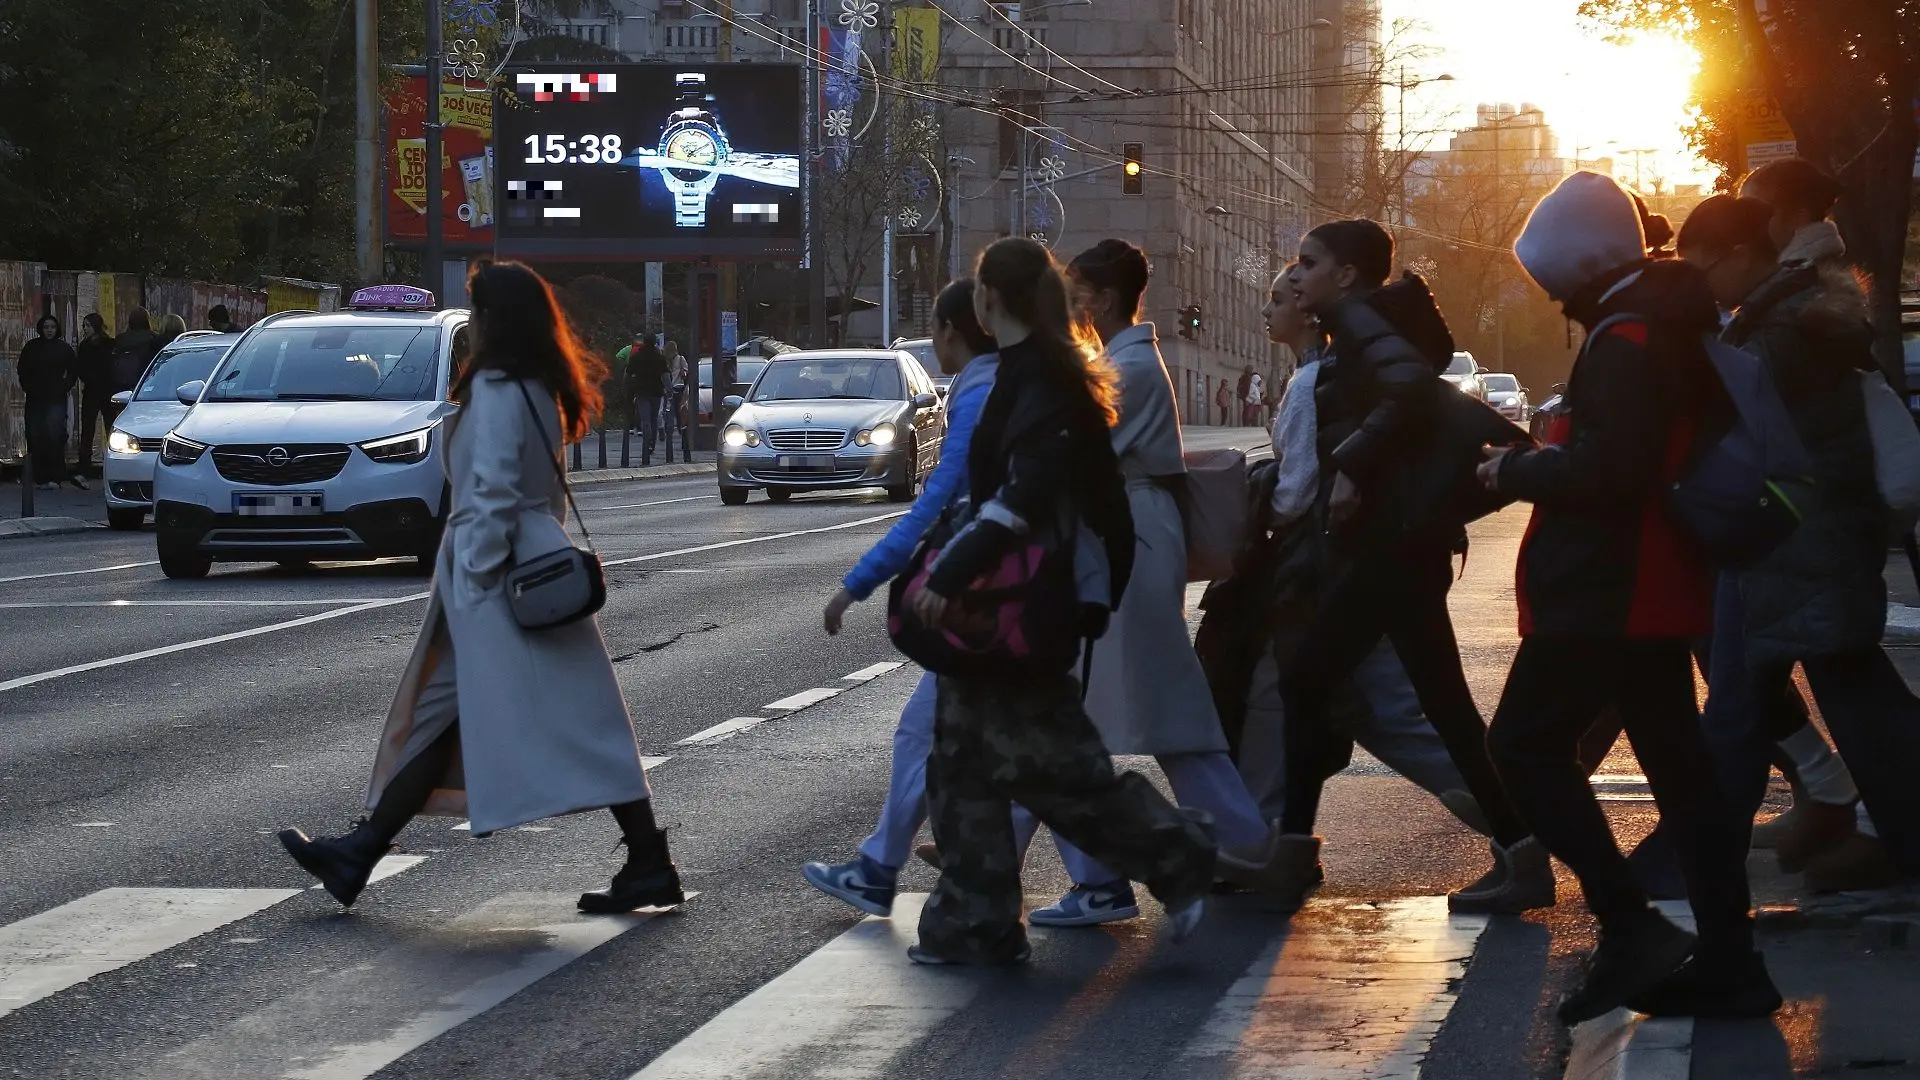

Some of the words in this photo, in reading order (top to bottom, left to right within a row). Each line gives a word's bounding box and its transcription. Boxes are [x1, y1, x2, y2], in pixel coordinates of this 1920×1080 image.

[443, 96, 464, 111] JOŠ
[403, 147, 427, 161] CEN
[524, 134, 622, 164] 15:38
[407, 161, 425, 176] ID
[402, 175, 425, 189] DO
[402, 294, 422, 302] 1937
